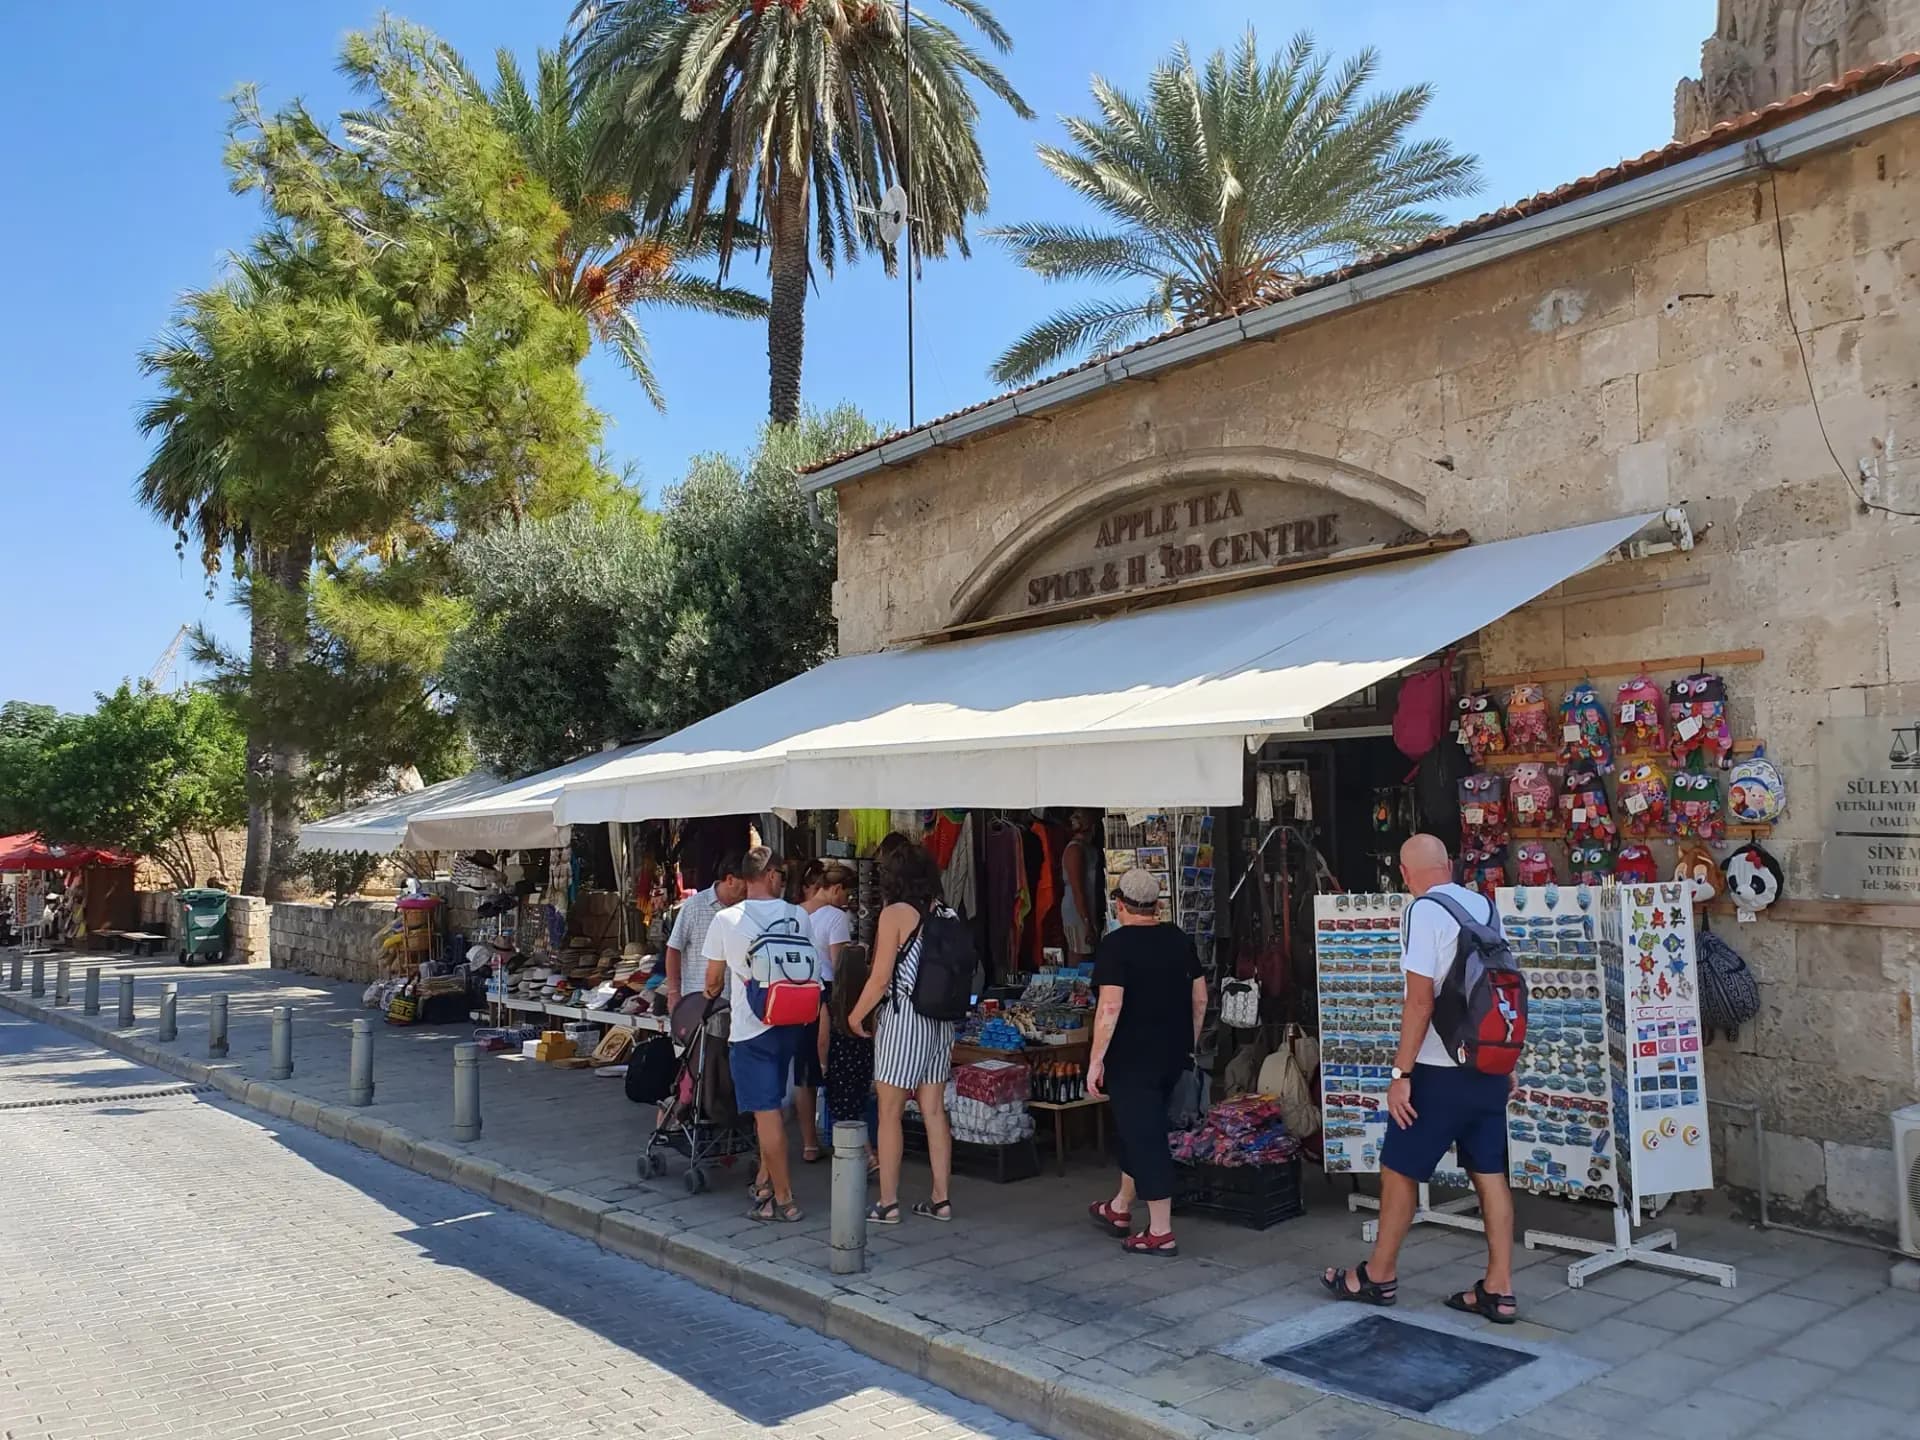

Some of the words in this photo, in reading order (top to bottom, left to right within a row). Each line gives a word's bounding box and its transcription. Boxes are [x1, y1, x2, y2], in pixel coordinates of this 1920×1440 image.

[1095, 505, 1178, 548] APPLE
[1183, 488, 1243, 527] TEA
[1028, 566, 1095, 605] SPICE
[1100, 562, 1119, 591] &
[1208, 513, 1338, 569] CENTRE
